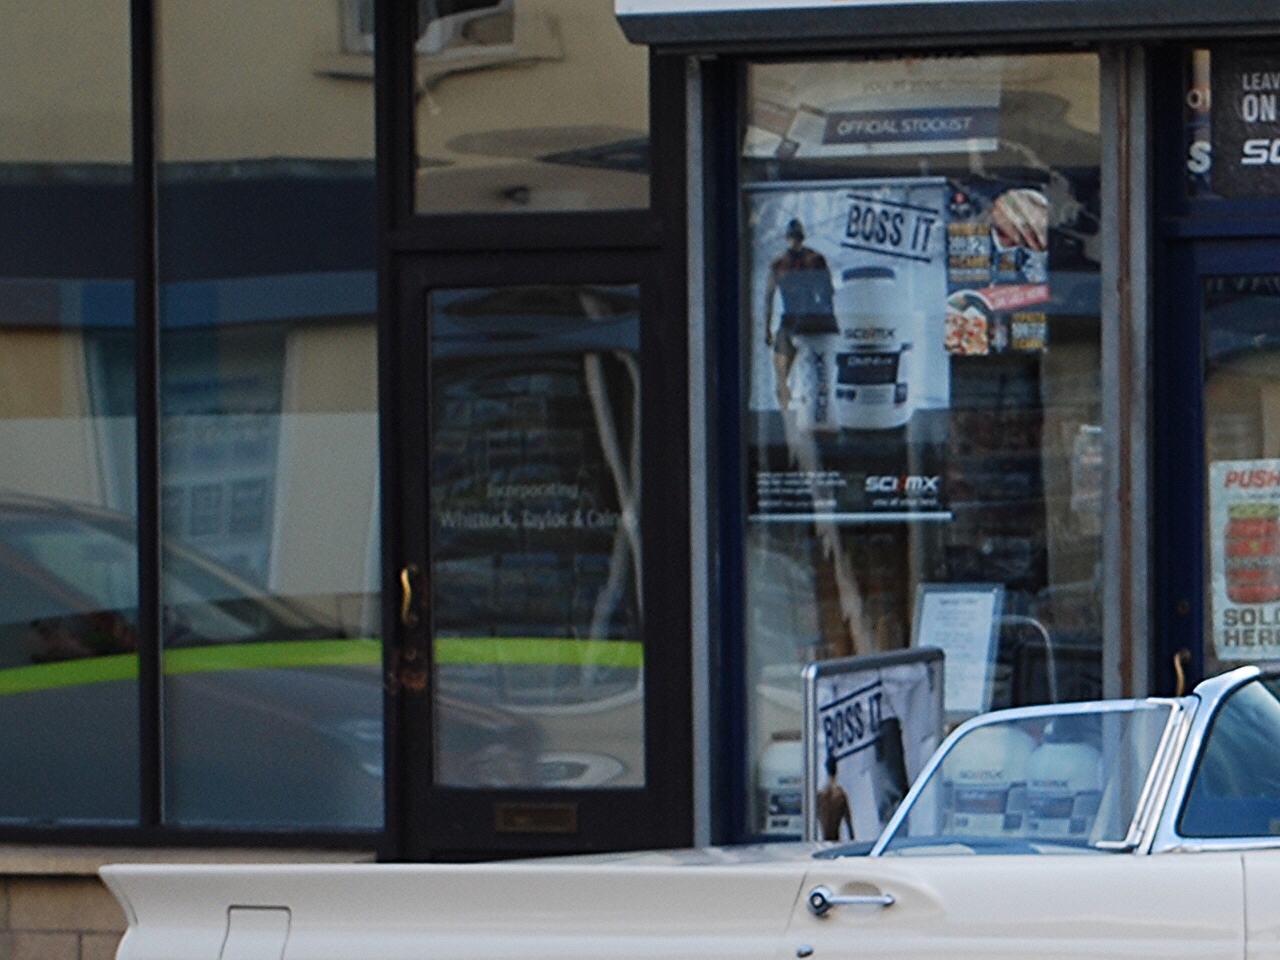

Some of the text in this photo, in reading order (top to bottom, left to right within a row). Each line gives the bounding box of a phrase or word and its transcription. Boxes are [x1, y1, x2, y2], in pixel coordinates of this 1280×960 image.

[1242, 93, 1277, 123] ON
[836, 116, 974, 136] OFFICIAL STOCKIST
[845, 204, 938, 254] BOSS IT
[486, 482, 579, 502] Incorporating
[572, 509, 585, 528] &
[823, 692, 883, 750] BOSS IT
